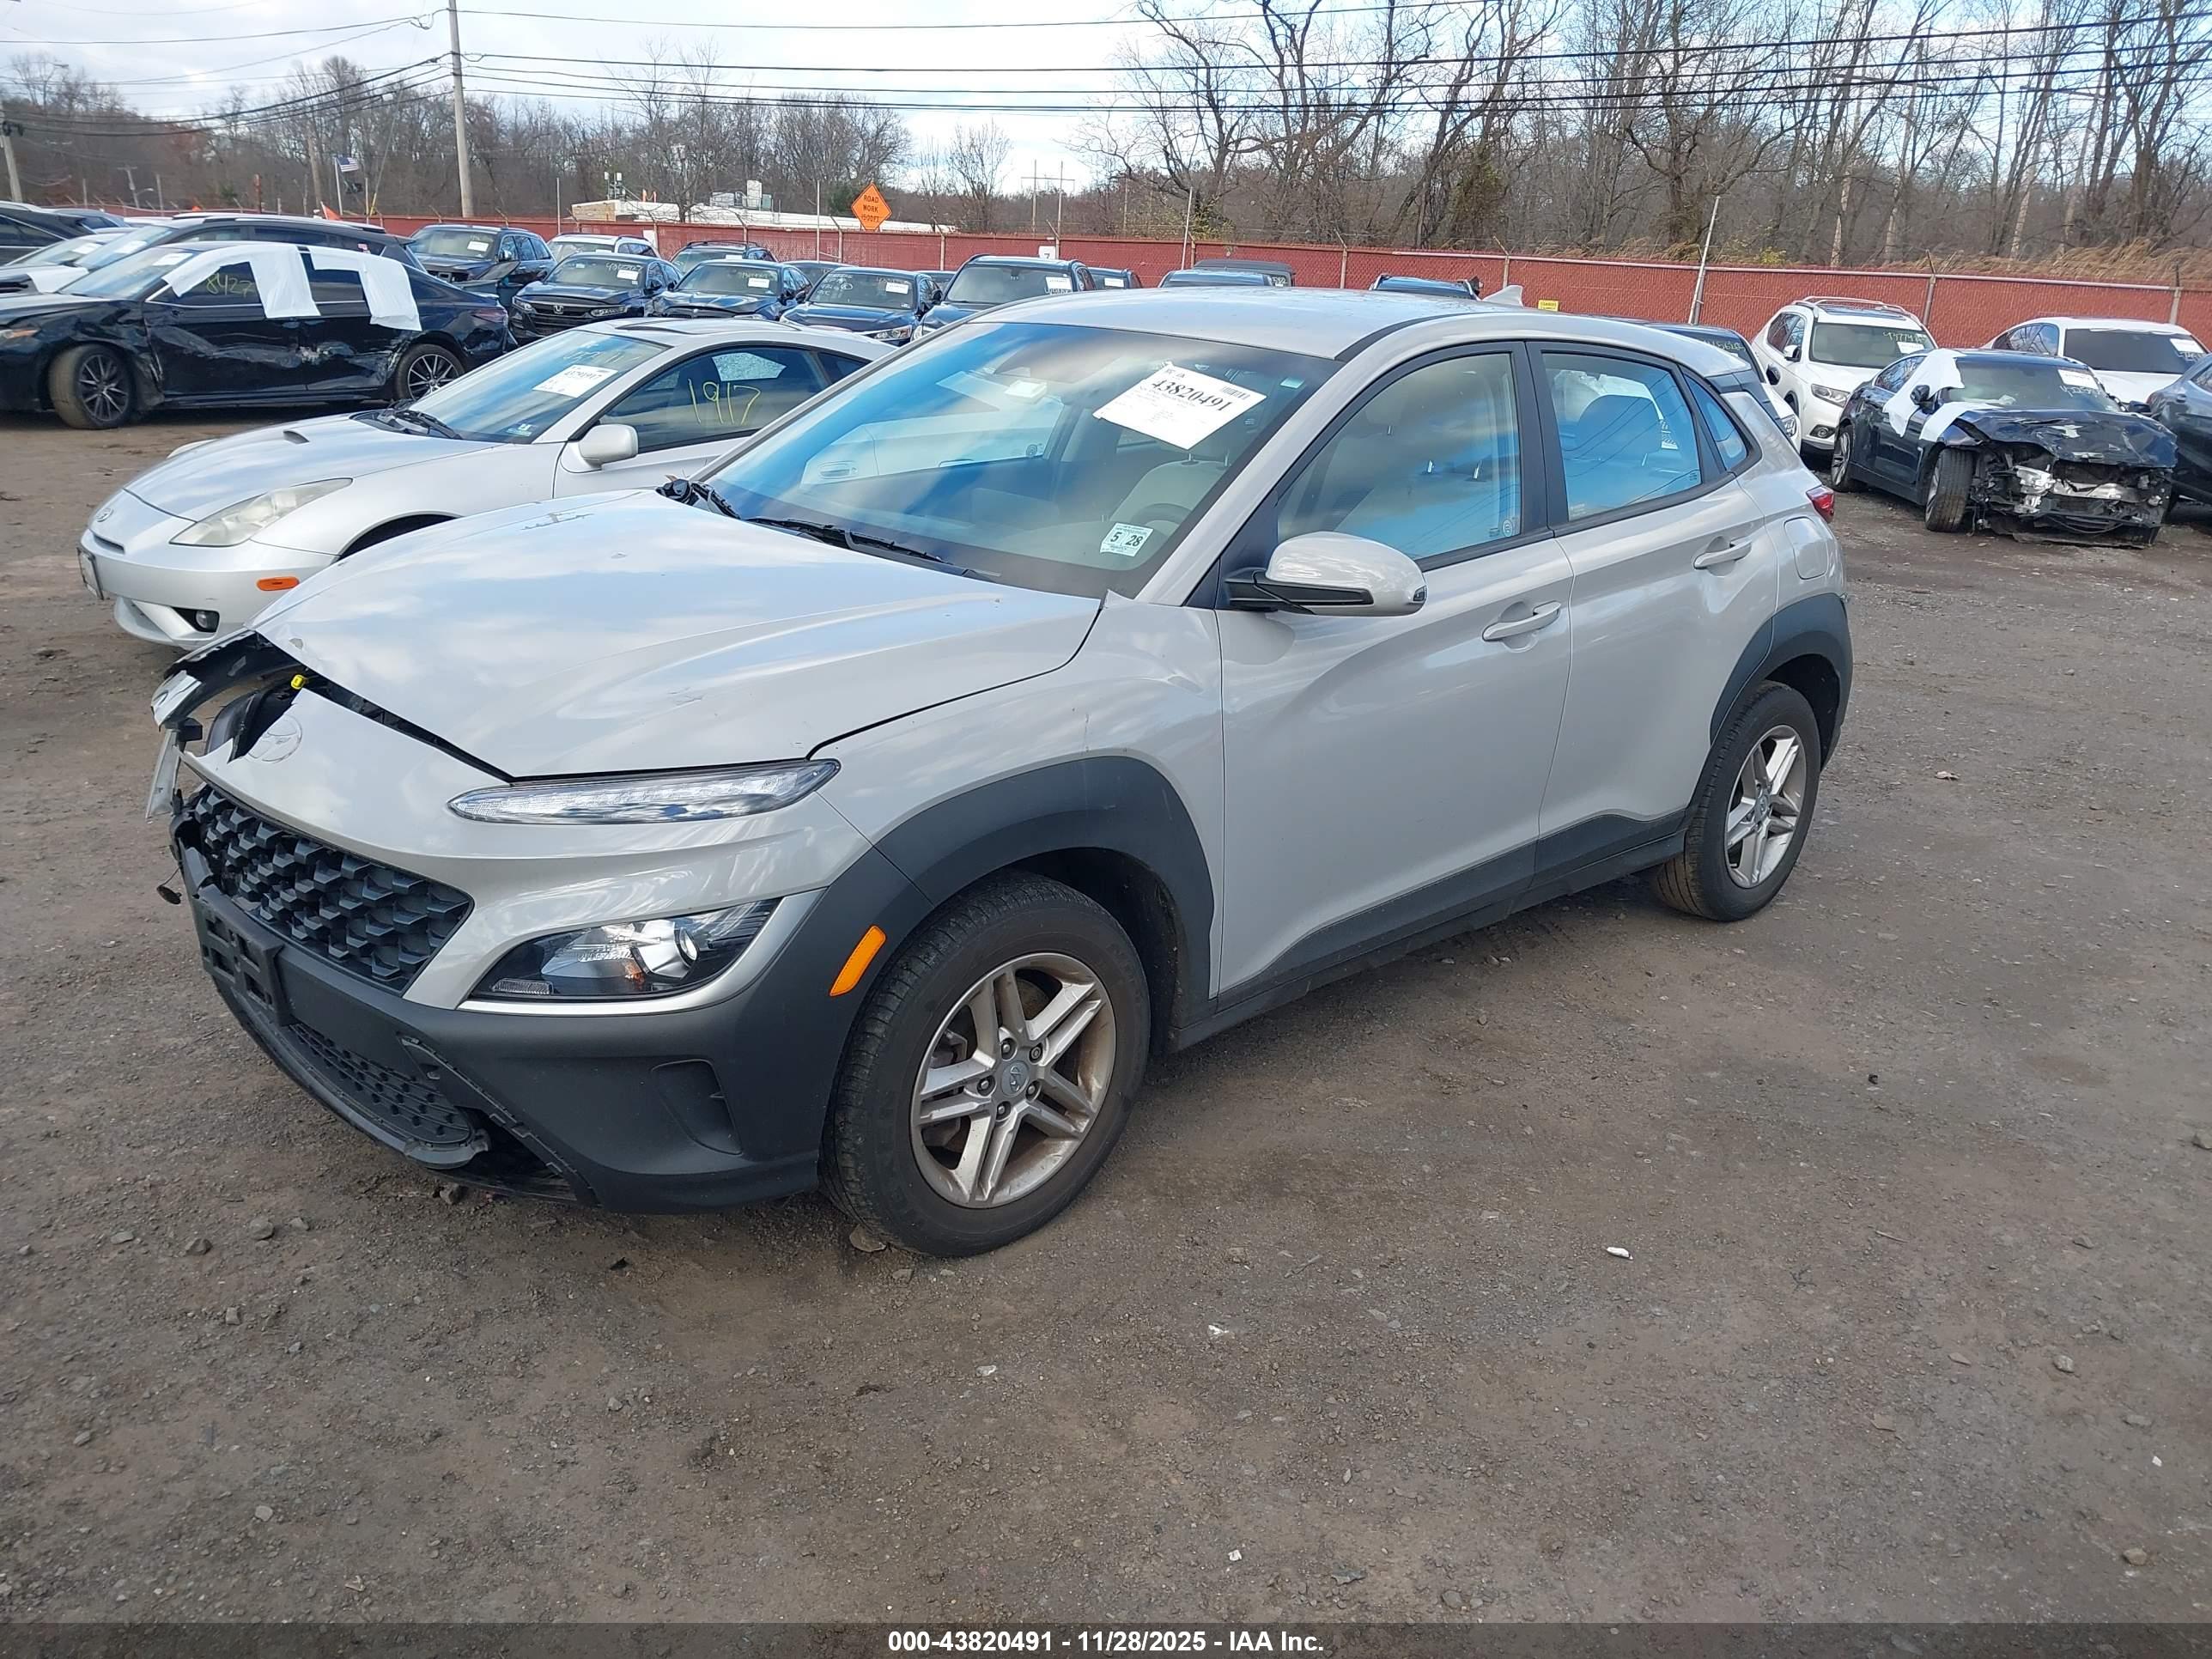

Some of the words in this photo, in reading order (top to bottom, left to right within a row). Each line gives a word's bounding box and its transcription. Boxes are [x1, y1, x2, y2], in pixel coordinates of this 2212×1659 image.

[863, 194, 879, 204] ROAD
[863, 204, 878, 213] WORK
[206, 272, 255, 298] 8427
[688, 378, 761, 425] 1917
[1151, 378, 1233, 411] 43820491
[1110, 532, 1122, 543] 5
[1125, 534, 1143, 547] 28
